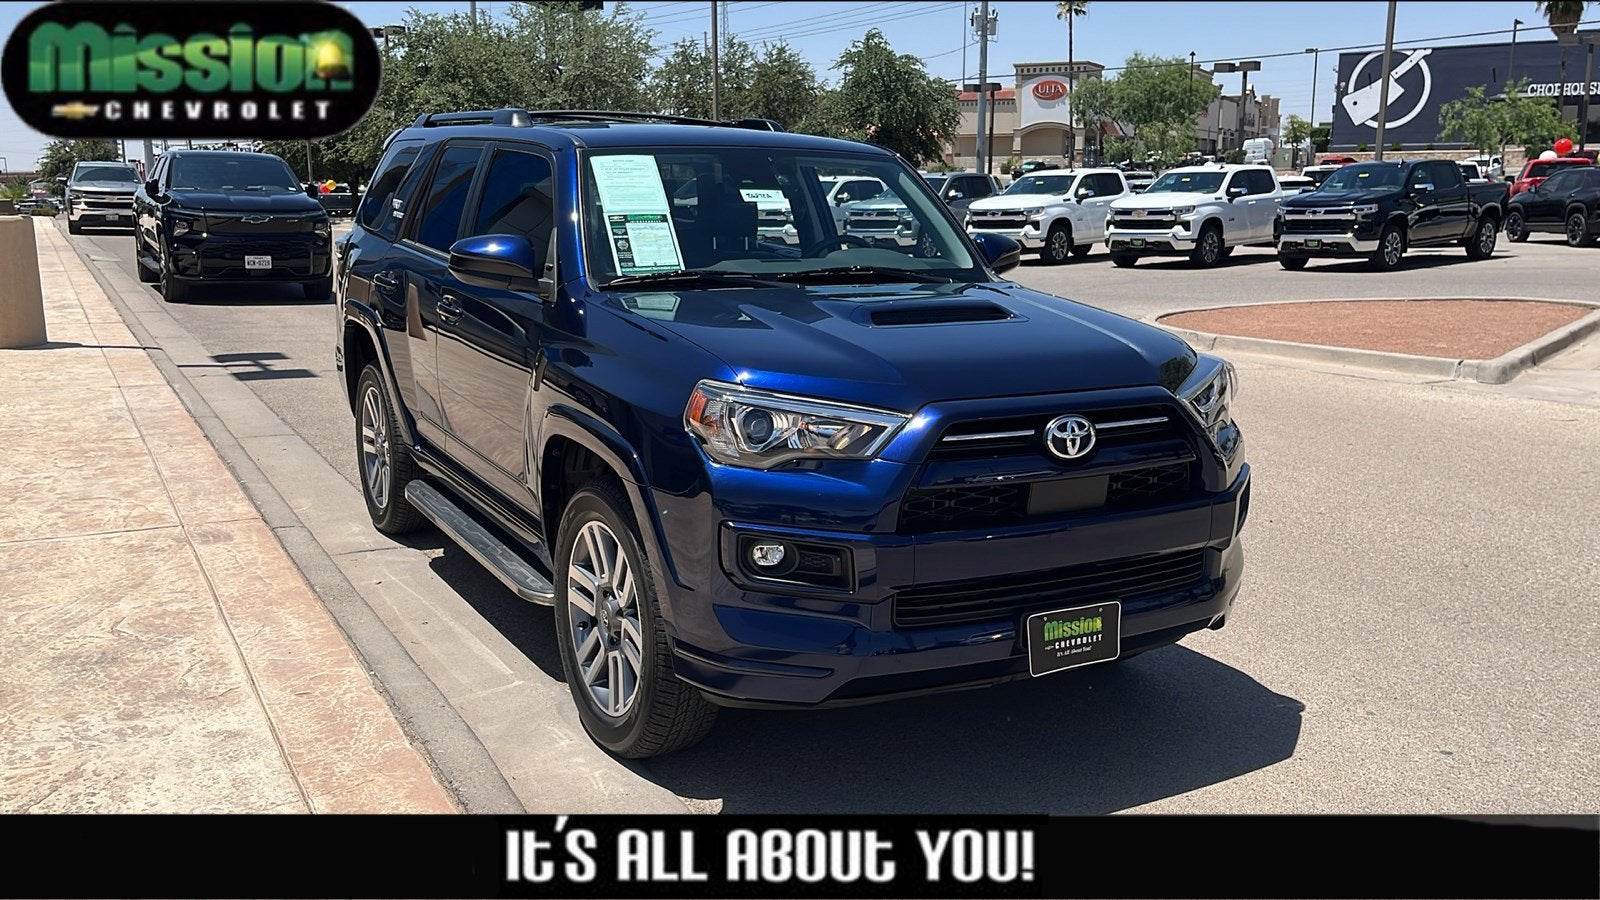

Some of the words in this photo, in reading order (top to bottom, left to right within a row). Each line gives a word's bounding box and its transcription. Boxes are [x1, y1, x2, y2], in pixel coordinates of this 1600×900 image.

[1038, 84, 1062, 93] ULTA
[1044, 617, 1102, 641] Mission
[1055, 634, 1103, 649] CHEVROLET
